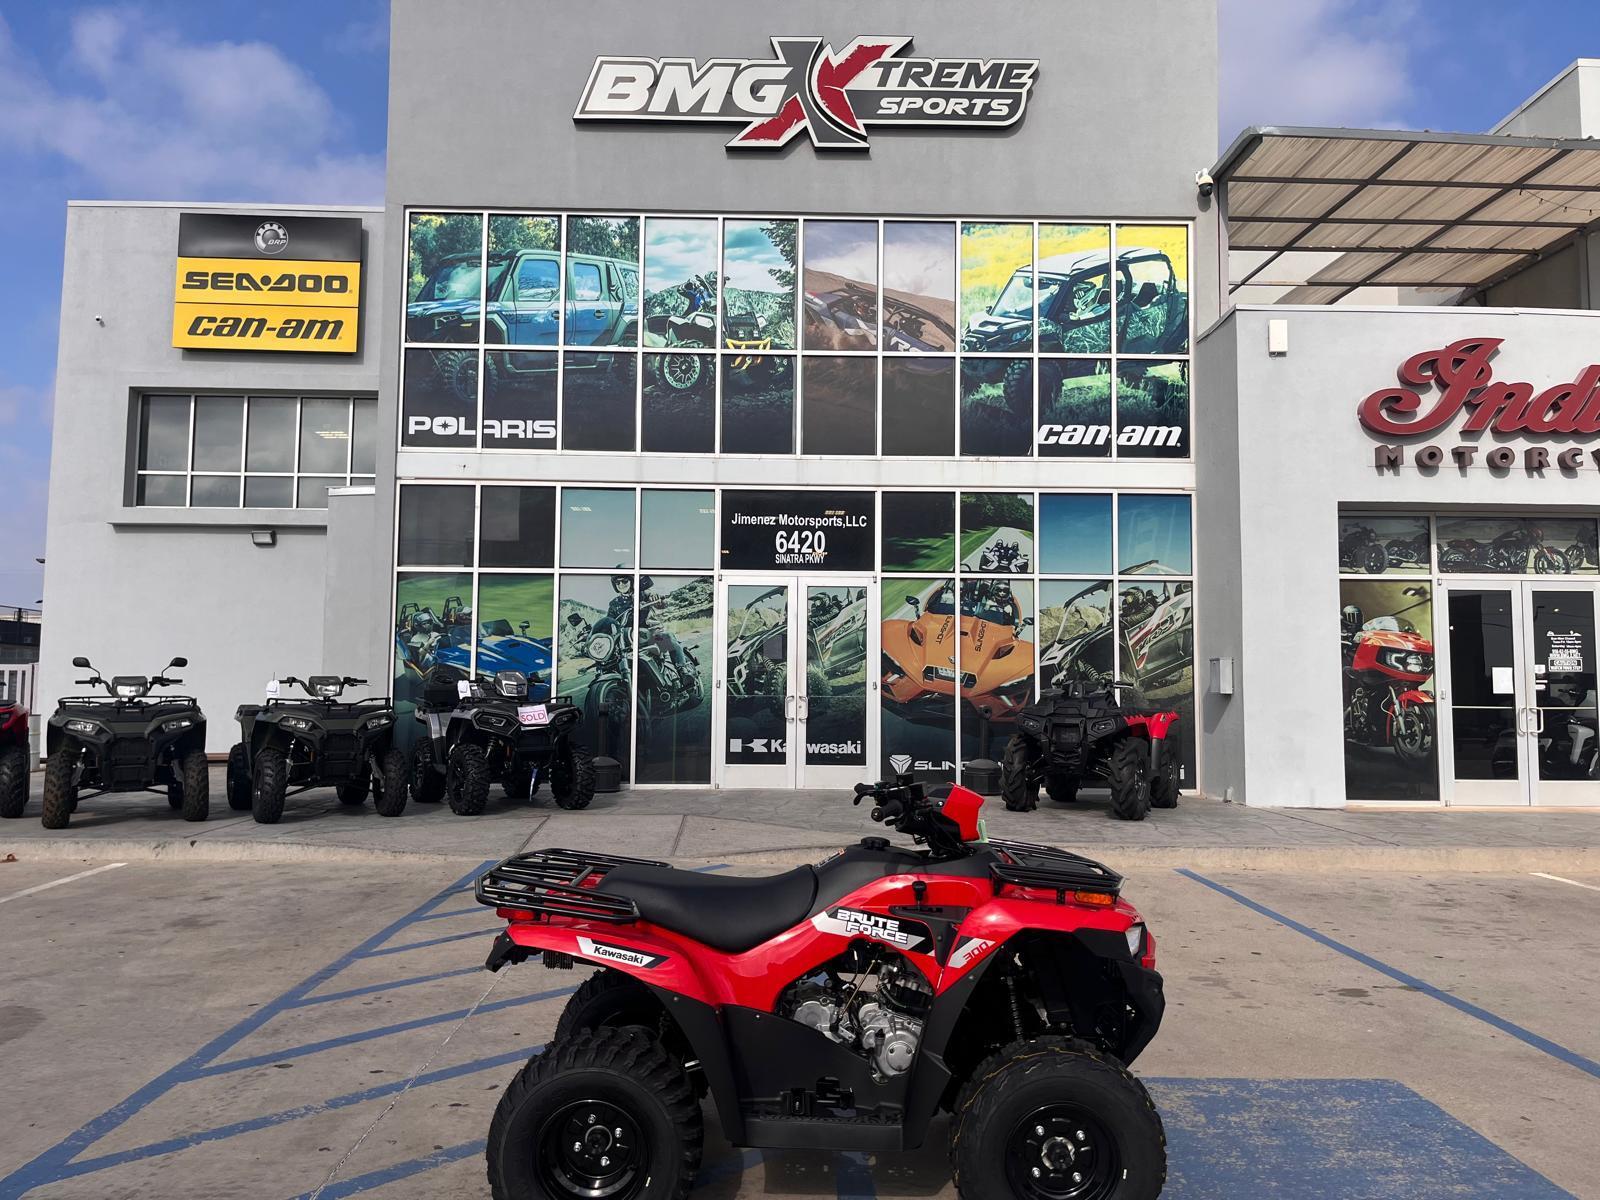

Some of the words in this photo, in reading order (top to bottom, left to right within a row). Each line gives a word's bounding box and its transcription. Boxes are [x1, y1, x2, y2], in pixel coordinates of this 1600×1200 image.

[876, 97, 1014, 116] SPORTS
[187, 315, 345, 340] can-am
[408, 415, 557, 439] POLARIS
[1374, 444, 1600, 468] MOTORC
[731, 513, 776, 526] Jimenez
[775, 530, 826, 554] 6420
[775, 554, 804, 564] SINATRA
[805, 554, 825, 564] PKWY
[520, 712, 545, 722] SOLD
[836, 908, 900, 931] BRUTE
[846, 920, 909, 945] FORCE
[593, 945, 644, 964] Kawasaki
[962, 941, 989, 963] 300
